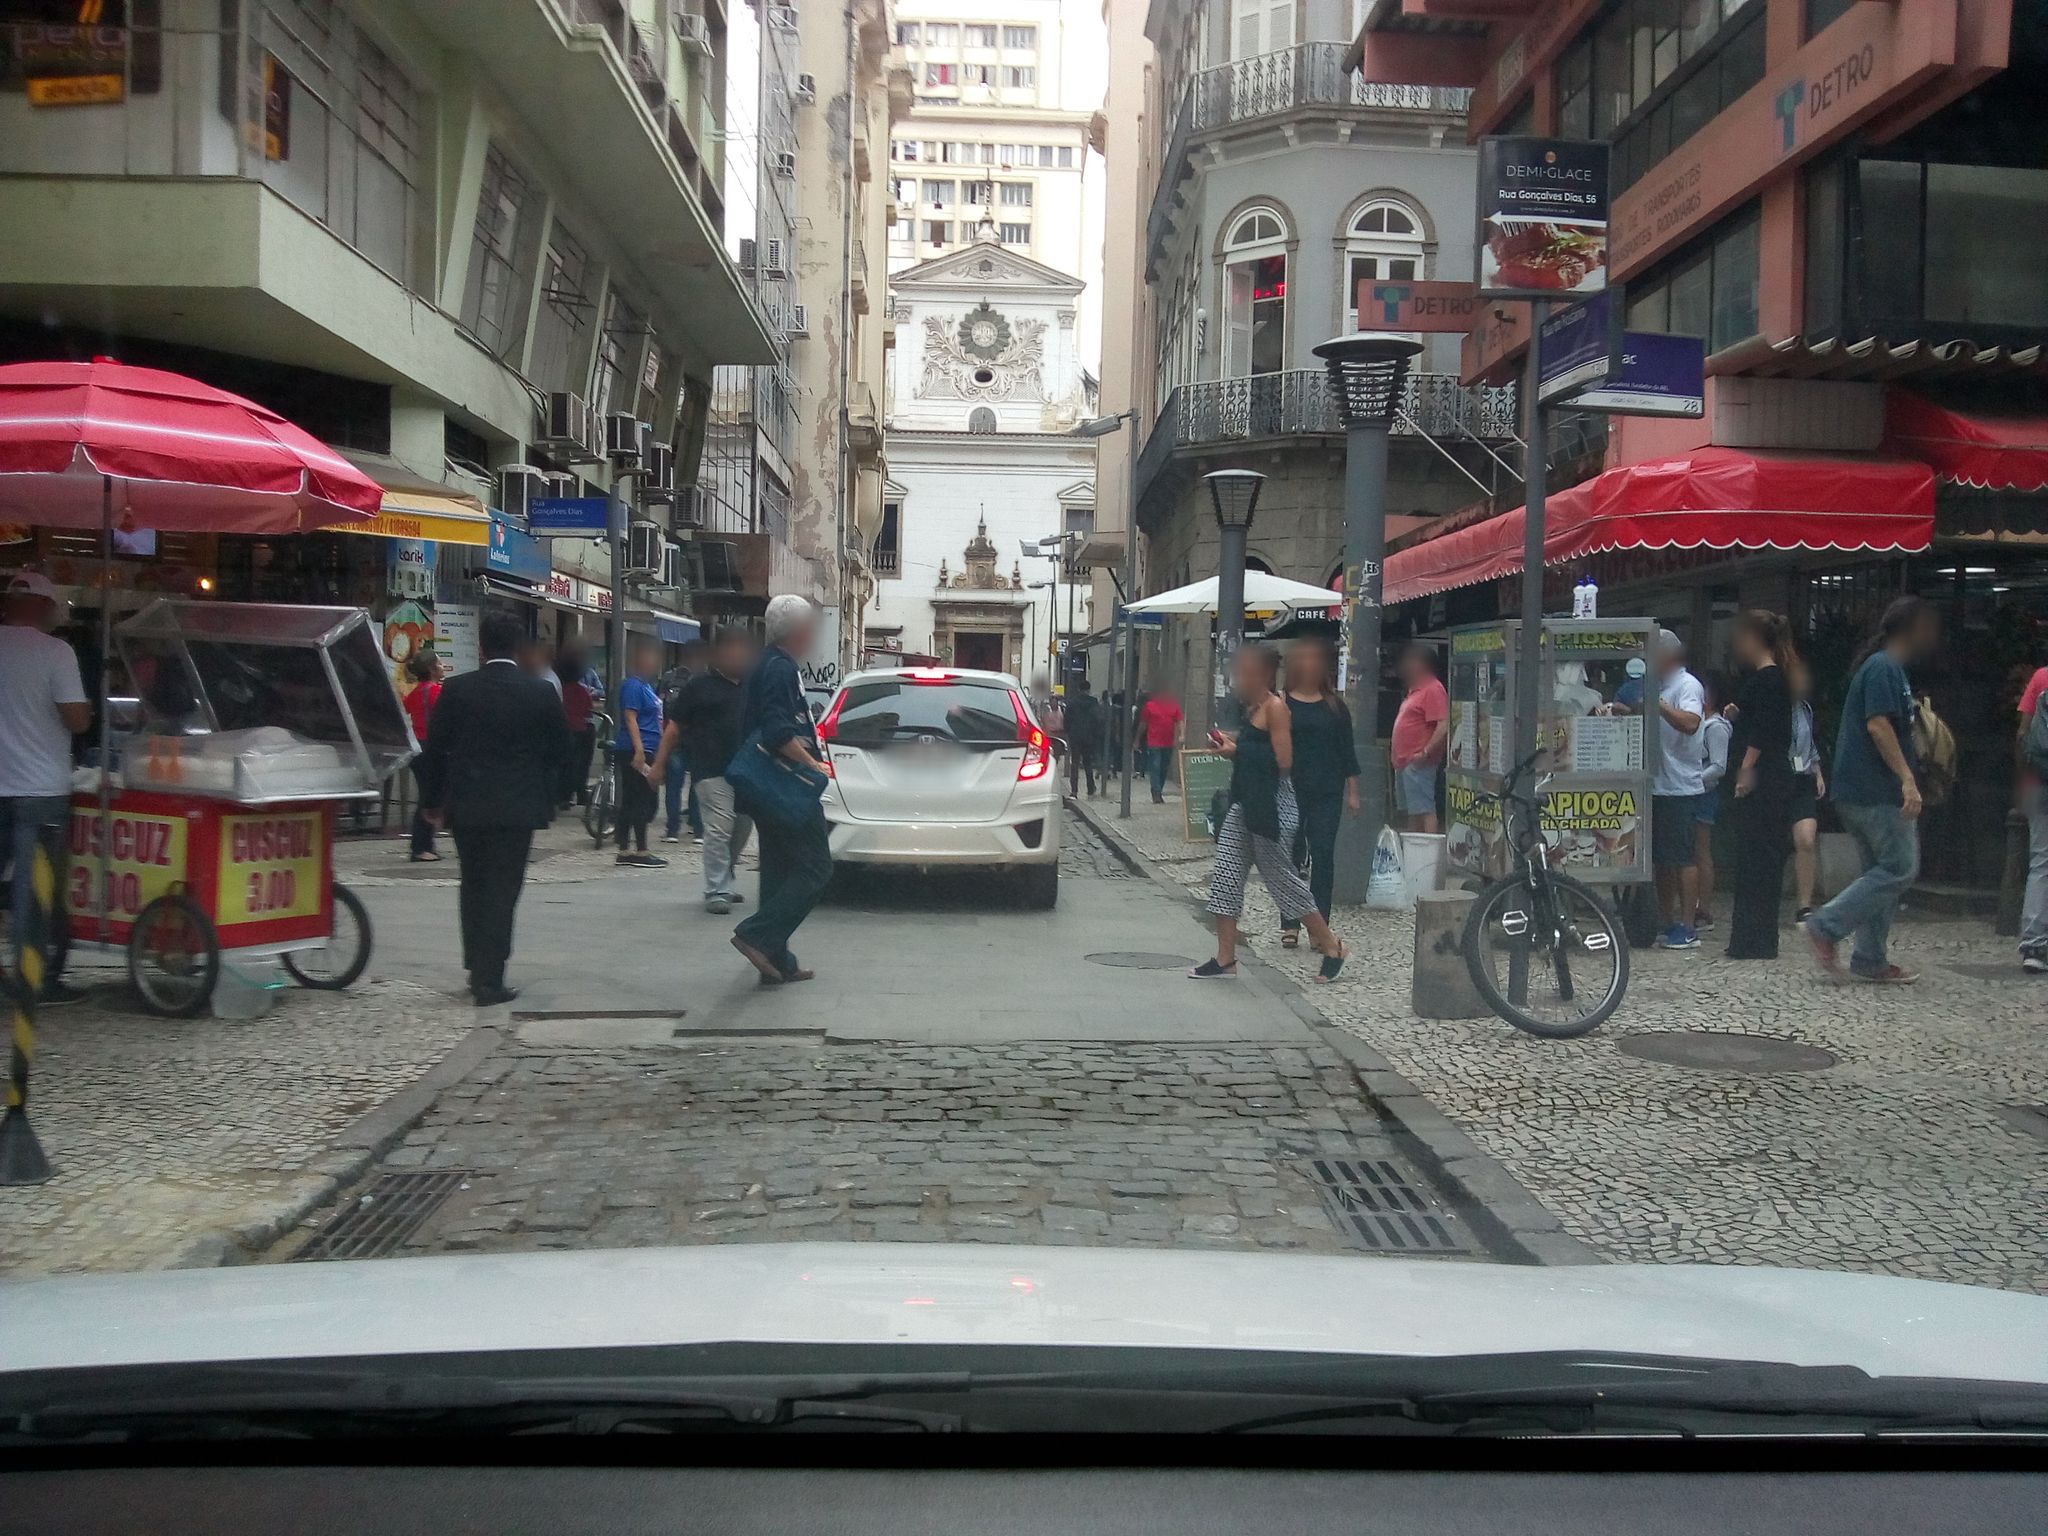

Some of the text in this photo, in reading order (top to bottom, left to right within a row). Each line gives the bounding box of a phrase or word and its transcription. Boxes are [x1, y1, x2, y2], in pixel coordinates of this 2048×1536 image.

[1810, 42, 1873, 119] DETRO
[1506, 165, 1592, 181] DEMI-GLACE
[1499, 190, 1597, 204] Rua Gonçalves Dias, 56
[1414, 296, 1473, 315] DETRO
[1621, 353, 1638, 365] ac
[1683, 400, 1699, 413] 28
[532, 507, 583, 516] Gonçalves Dias
[1297, 609, 1326, 620] CAFÉ
[72, 815, 171, 866] USCUZ
[232, 818, 312, 864] CUSCUZ
